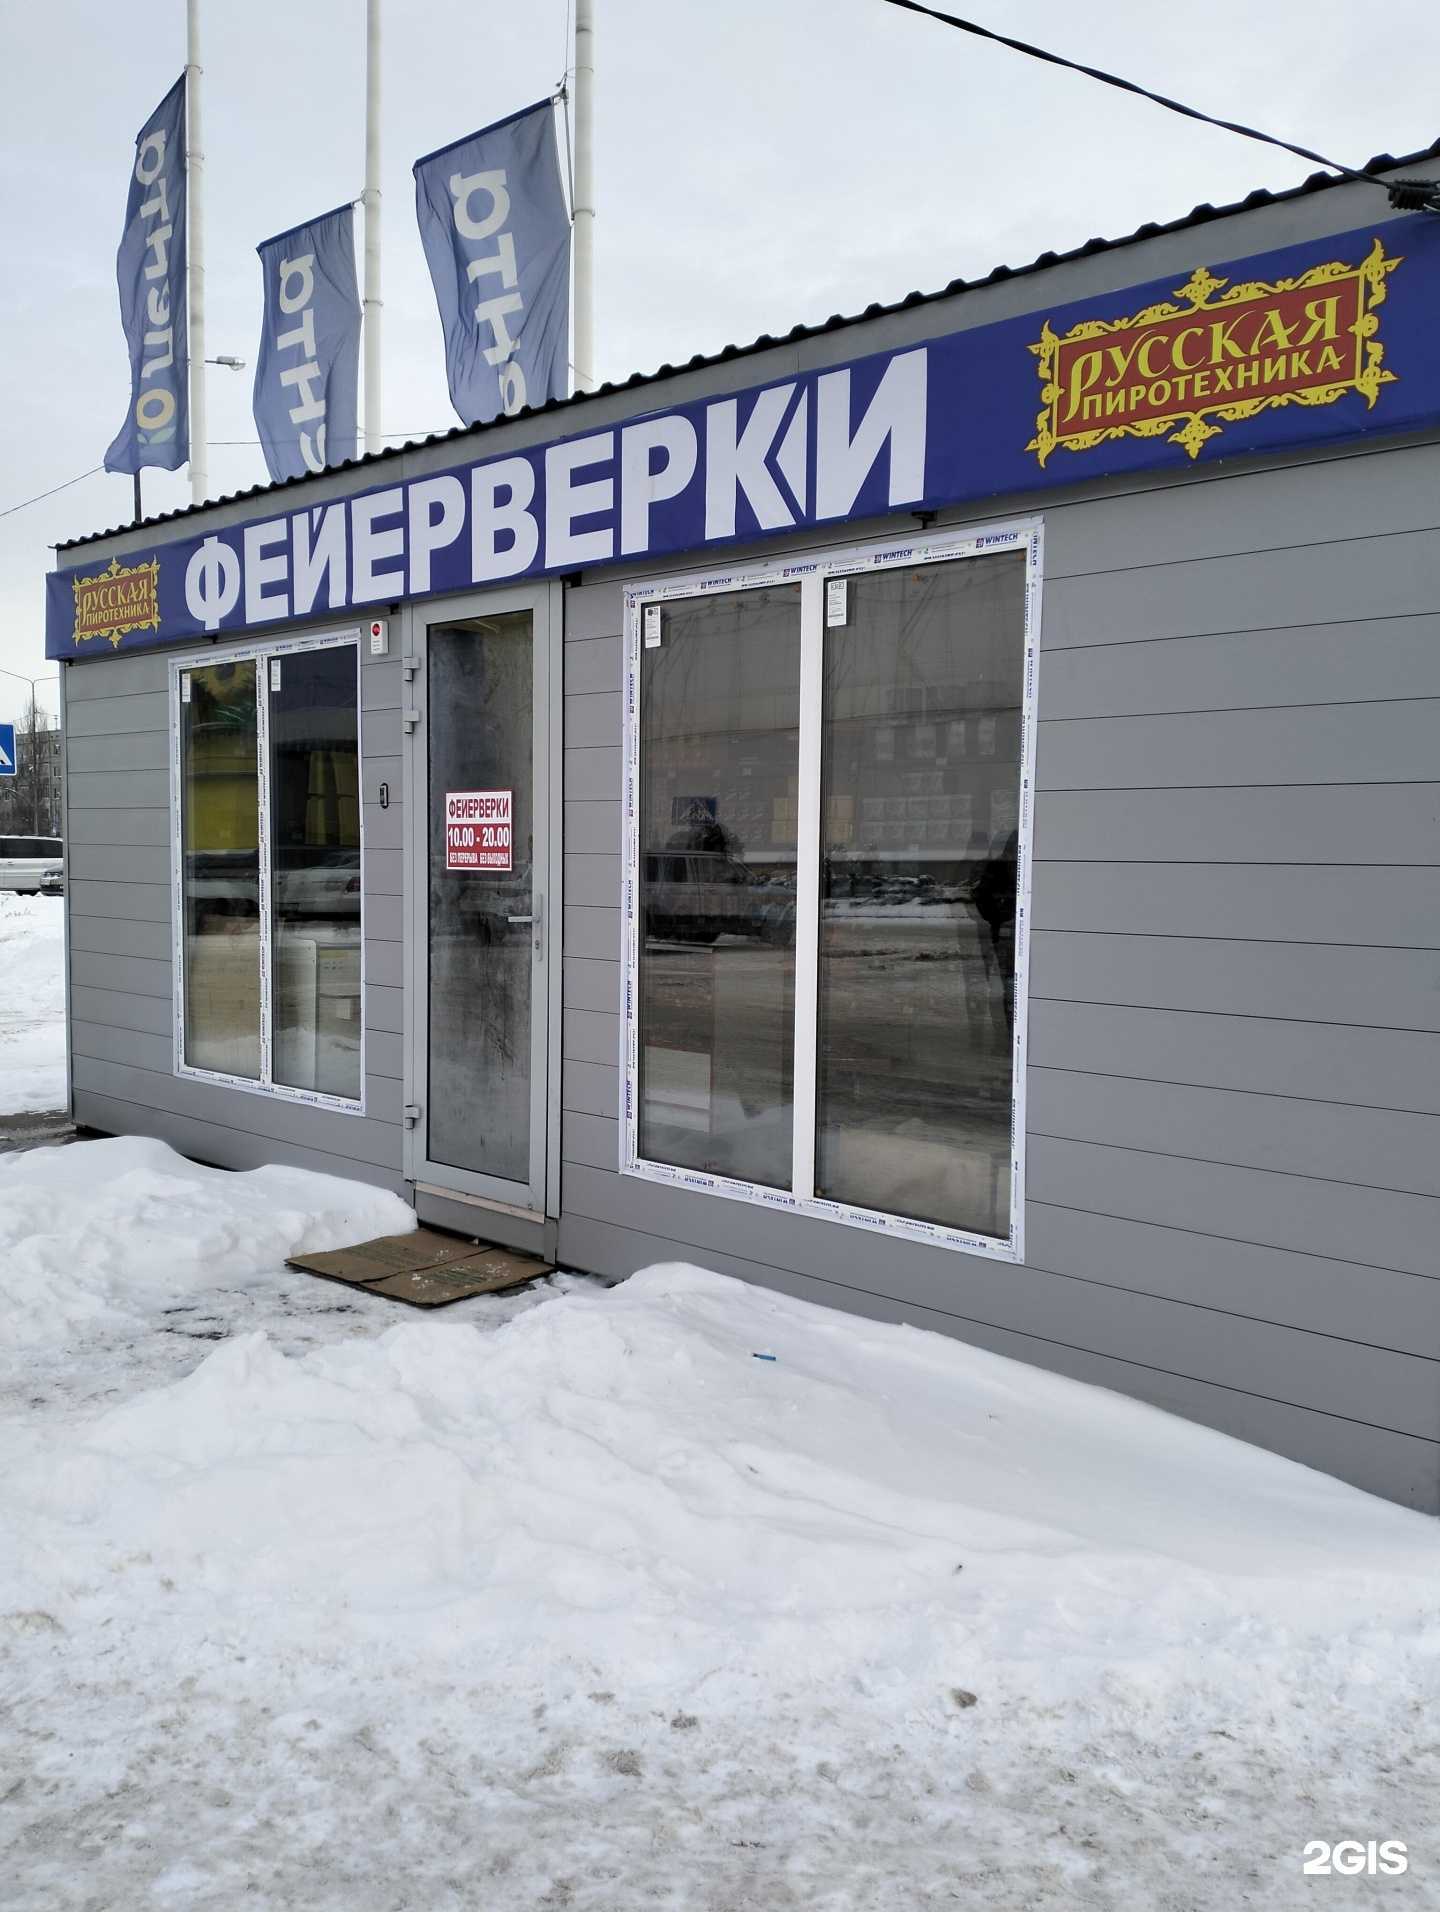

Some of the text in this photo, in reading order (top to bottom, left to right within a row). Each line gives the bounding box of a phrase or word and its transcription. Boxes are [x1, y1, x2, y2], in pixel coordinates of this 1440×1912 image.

[1062, 295, 1342, 423] РУССКАЯ
[1083, 345, 1346, 420] ПИРОТЕХНИКА
[985, 533, 1018, 545] WINTECH
[883, 549, 912, 560] WINTECH
[791, 564, 817, 573] WINTECH
[81, 579, 148, 625] РУССКАЯ
[86, 605, 149, 625] ПИРОТЕХНИКА
[448, 827, 474, 847] 10.00
[482, 826, 509, 847] 20.00
